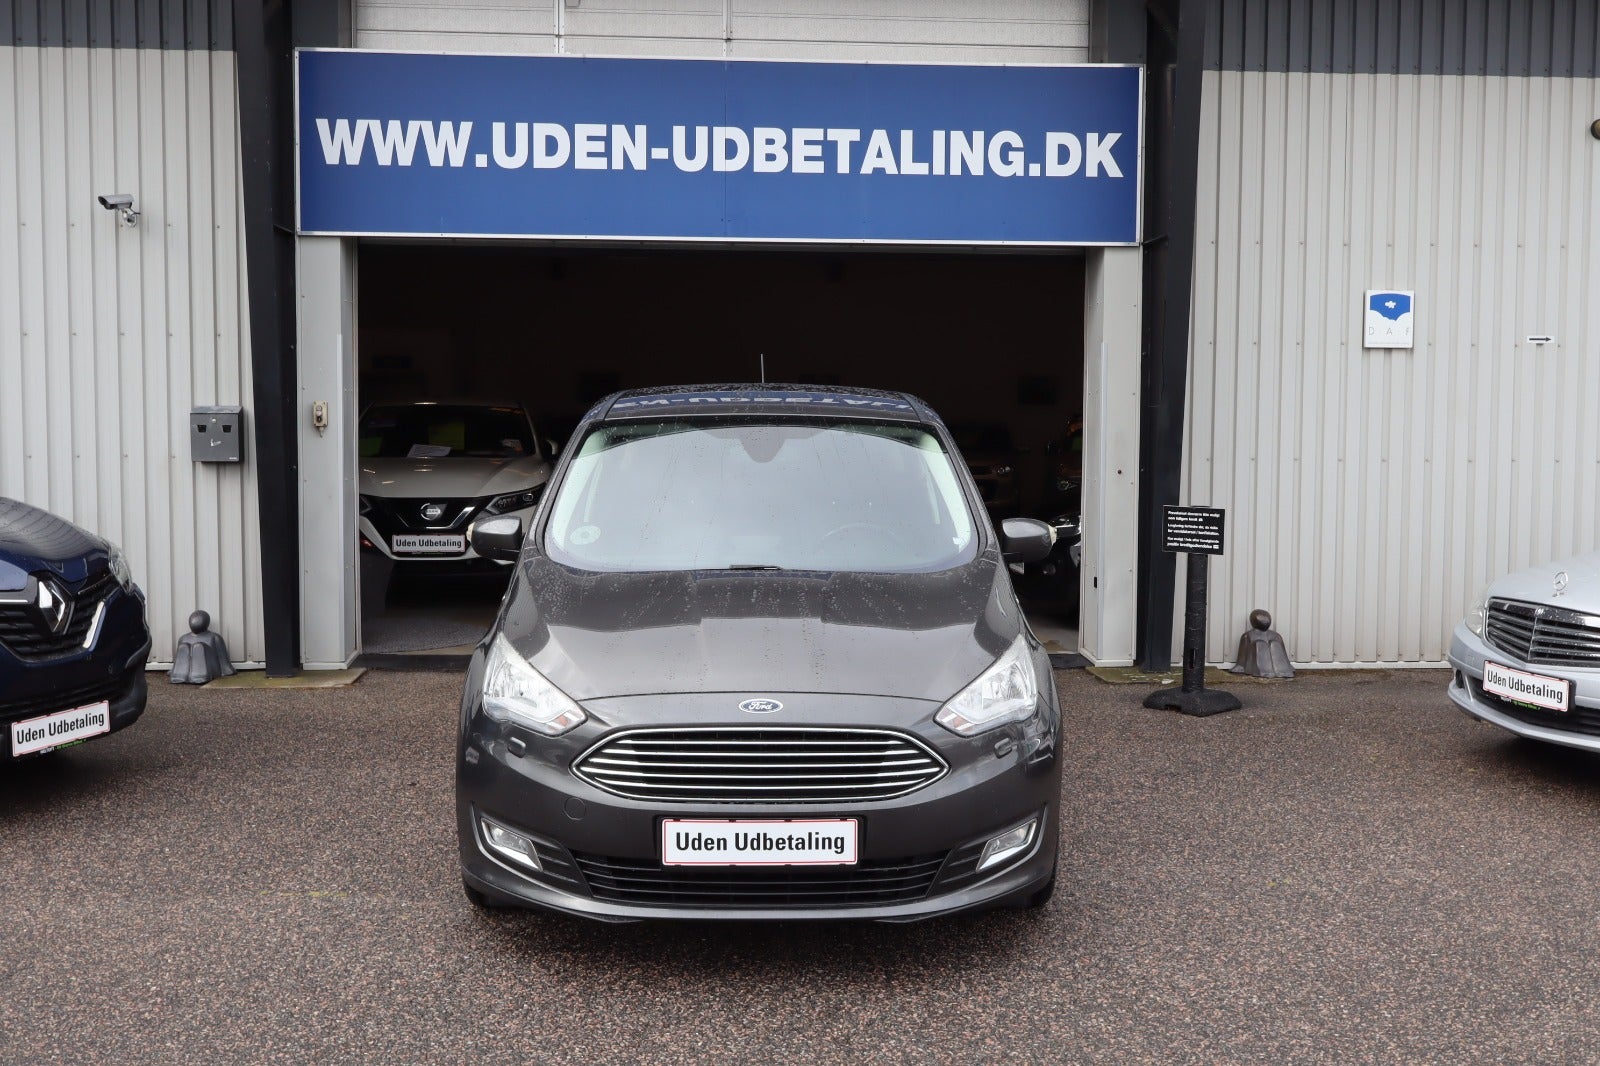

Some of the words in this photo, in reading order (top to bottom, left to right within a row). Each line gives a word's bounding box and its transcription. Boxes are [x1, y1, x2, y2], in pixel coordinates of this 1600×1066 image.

[315, 118, 1124, 178] WWW.UDEN-UDBETALING.DK
[396, 539, 416, 547] Uden
[419, 539, 461, 548] Udbetaling
[1487, 669, 1507, 687] Uden
[1509, 676, 1563, 703] Udbetaling
[748, 701, 773, 711] Ford
[17, 728, 45, 744] Uden
[49, 713, 104, 736] Udbetaling
[676, 832, 727, 851] Uden
[734, 832, 845, 854] Udbetaling
